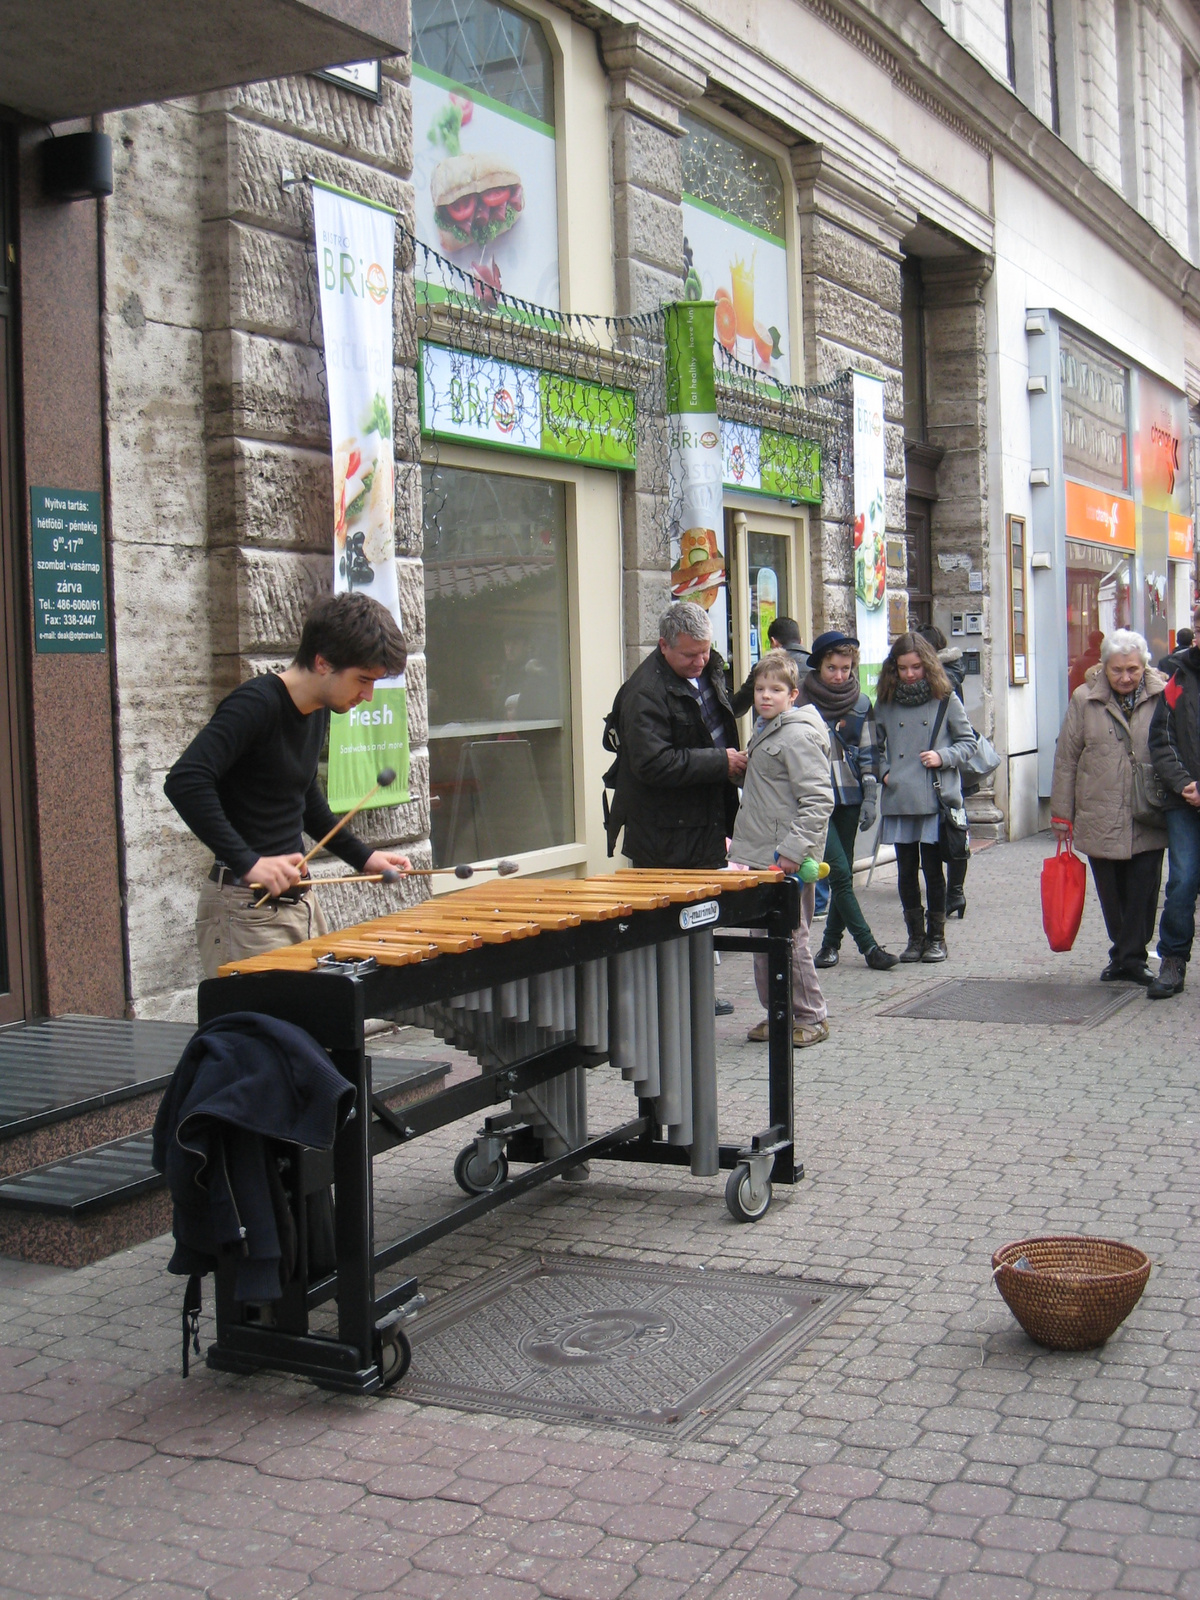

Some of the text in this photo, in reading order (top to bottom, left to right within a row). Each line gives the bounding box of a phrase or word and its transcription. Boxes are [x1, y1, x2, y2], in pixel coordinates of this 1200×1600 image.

[322, 231, 350, 249] BISTRO
[689, 356, 697, 390] healthy
[690, 391, 698, 406] Eat
[44, 497, 89, 512] Nyitva tartás:
[69, 520, 98, 535] péntekig
[37, 559, 66, 571] szombat
[69, 560, 100, 575] vasárnap
[57, 579, 83, 593] zárva
[39, 598, 101, 611] Tel.: 486-6060/61
[44, 613, 97, 626] Fax: 338-2447
[39, 629, 56, 640] e-mail:
[371, 741, 386, 751] and
[388, 742, 404, 750] more
[530, 1314, 593, 1347] POSTA
